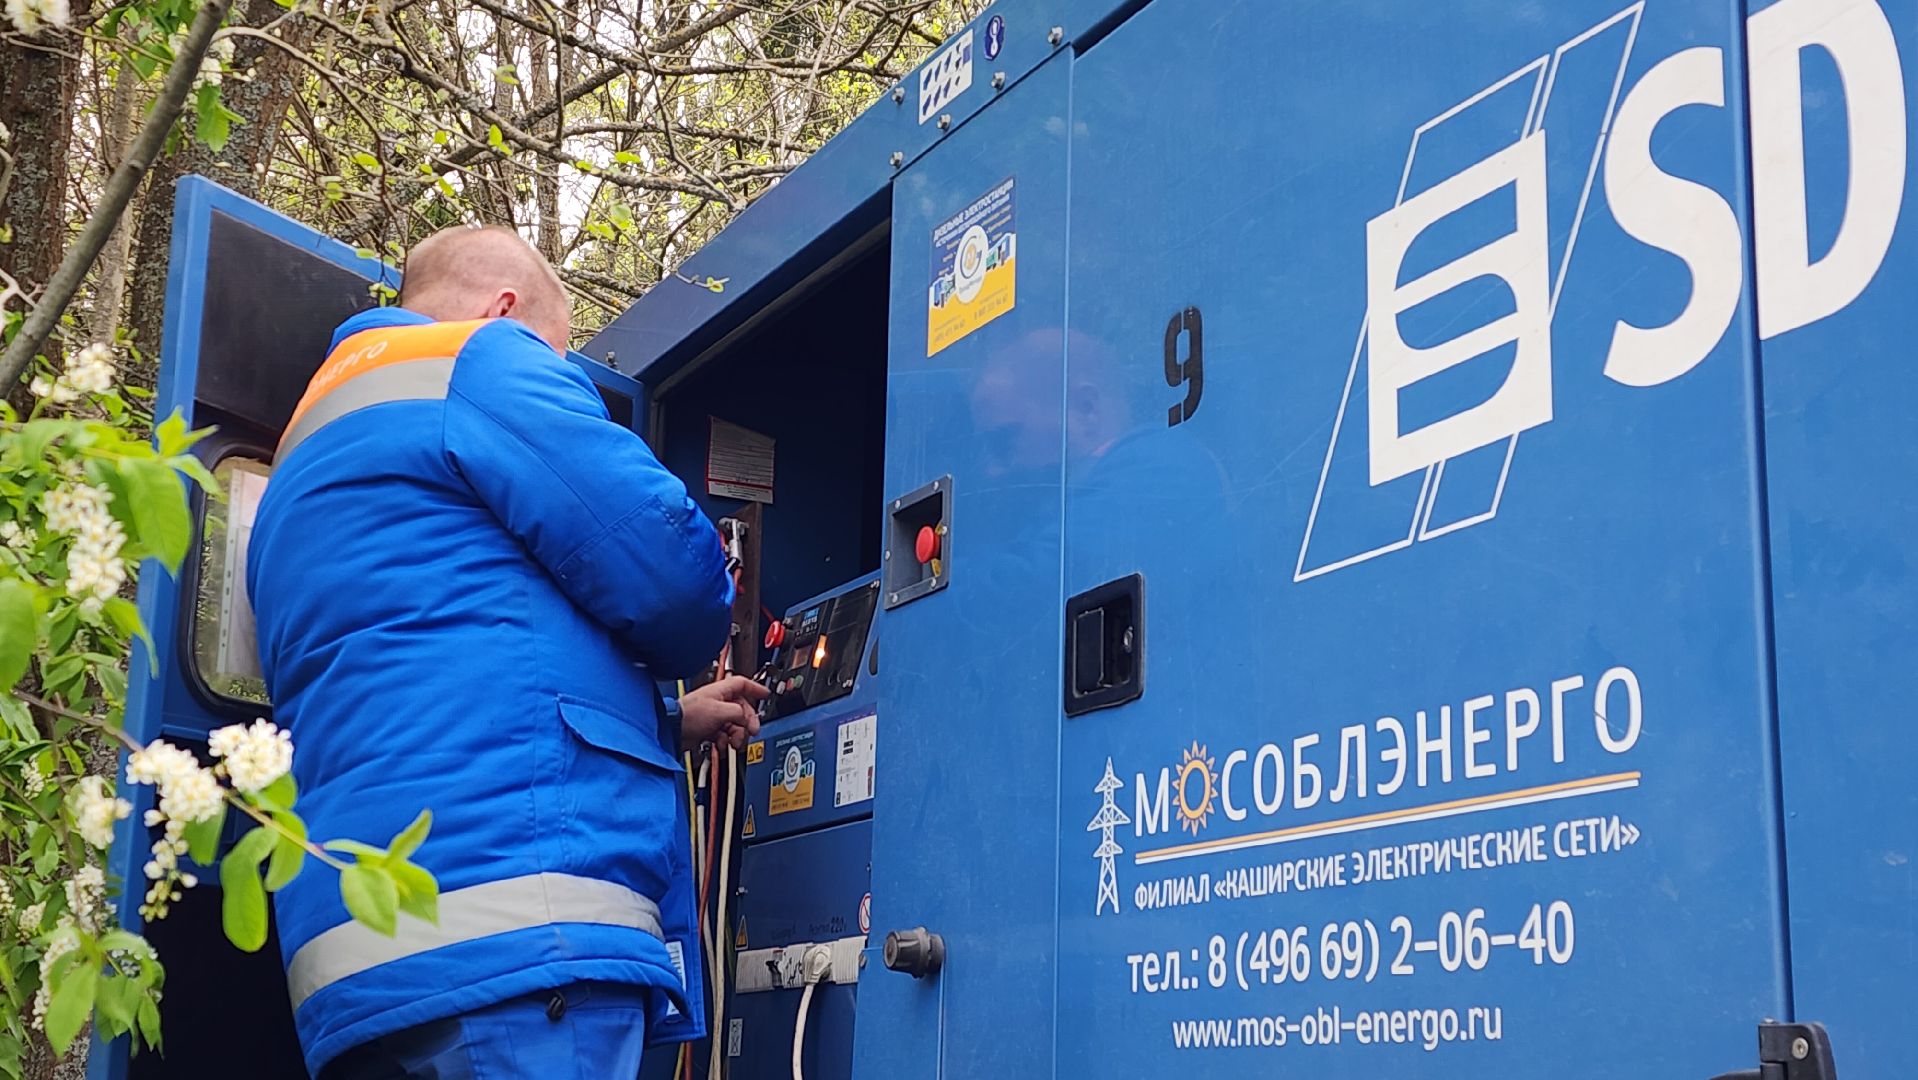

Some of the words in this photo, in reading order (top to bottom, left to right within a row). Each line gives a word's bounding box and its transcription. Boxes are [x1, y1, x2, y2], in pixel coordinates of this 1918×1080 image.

[1164, 305, 1203, 428] 9
[1135, 666, 1642, 837] МОСОБЛЭНЕРГО
[1135, 874, 1210, 910] ФИЛИАЛ
[1214, 854, 1347, 899] «КАШИРСКИЕ
[1351, 825, 1548, 884] ЭЛЕКТРИЧЕСКИЕ
[1553, 815, 1640, 858] СЕТИ»
[1127, 949, 1199, 993] тел.:
[1208, 935, 1227, 988] 8
[1236, 926, 1311, 991] (496
[1320, 919, 1380, 982] 69)
[1390, 900, 1575, 975] 2-06-40
[1173, 1006, 1502, 1050] www.mos-obl-energo.ru
